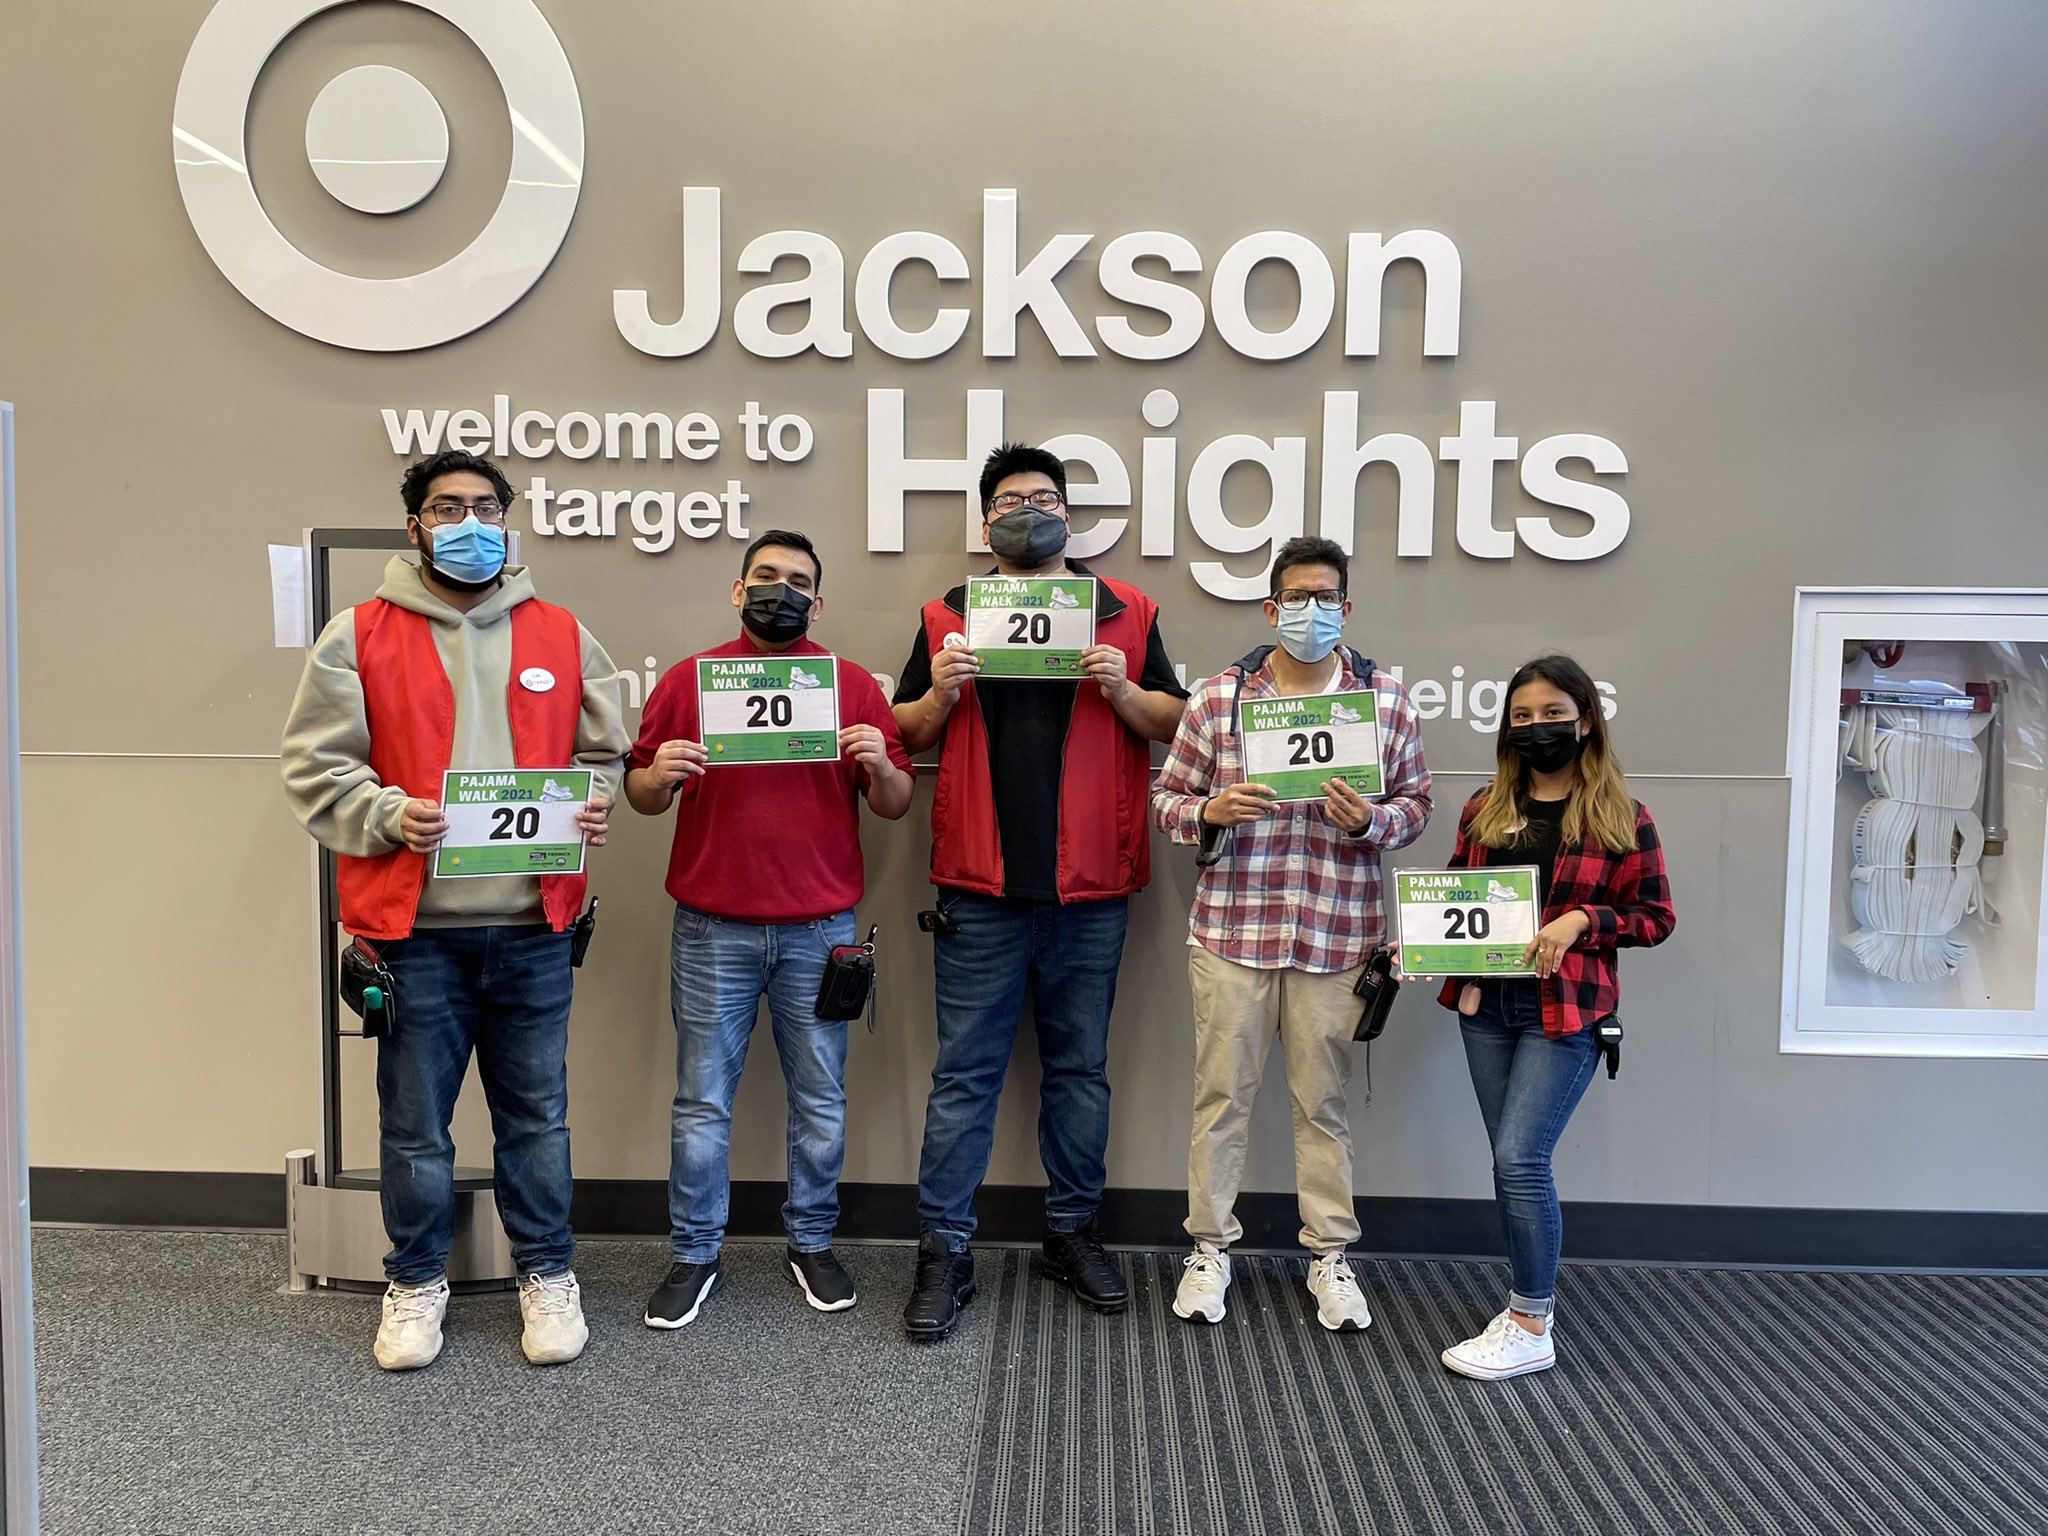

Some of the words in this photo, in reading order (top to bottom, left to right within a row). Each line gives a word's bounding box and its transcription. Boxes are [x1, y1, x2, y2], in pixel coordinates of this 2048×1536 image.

[613, 186, 1462, 360] Jackson
[381, 394, 720, 460] welcome
[738, 401, 814, 462] to
[867, 388, 1630, 601] Heights
[524, 476, 750, 553] target
[981, 582, 1028, 594] PAJAMA
[981, 596, 1012, 607] WALK
[1016, 596, 1043, 606] 2021
[1008, 613, 1050, 644] 20
[711, 663, 765, 675] PAJAMA
[712, 678, 749, 689] WALK
[752, 677, 783, 688] 2021
[1253, 701, 1305, 716] PAJAMA
[1390, 665, 1617, 733] eigs
[746, 695, 792, 727] 20
[1254, 717, 1290, 729] WALK
[1293, 714, 1324, 726] 2021
[1287, 731, 1334, 765] 20
[460, 775, 517, 787] PAJAMA
[459, 790, 498, 802] WALK
[501, 789, 534, 800] 2021
[489, 807, 540, 840] 20
[1409, 876, 1462, 888] PAJAMA
[1410, 890, 1446, 901] WALK
[1450, 890, 1480, 901] 2021
[1443, 908, 1490, 939] 20
